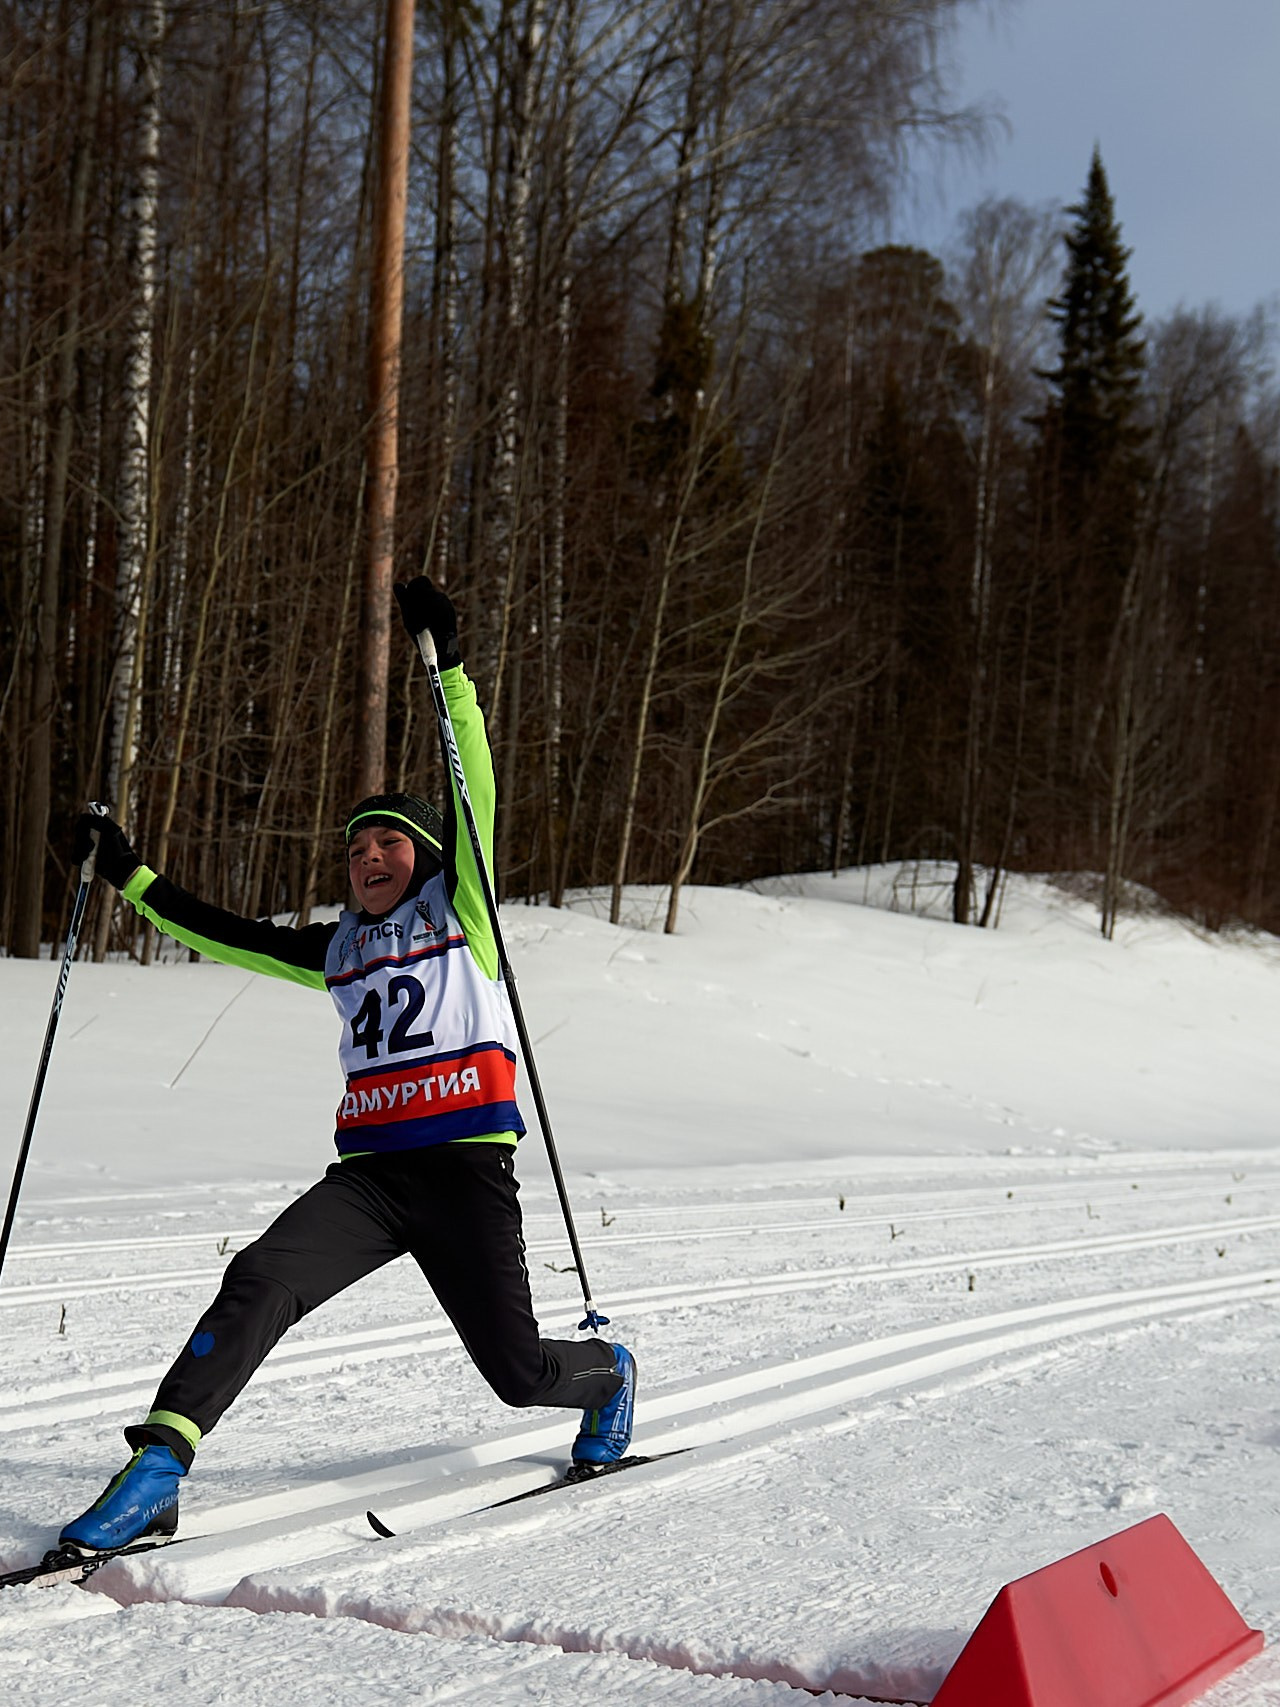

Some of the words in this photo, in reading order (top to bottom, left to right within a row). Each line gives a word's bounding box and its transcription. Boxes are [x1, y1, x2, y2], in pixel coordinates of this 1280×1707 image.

[368, 922, 404, 943] ПСБ
[350, 974, 435, 1060] 42
[337, 1066, 481, 1121] ДМУРТИЯ
